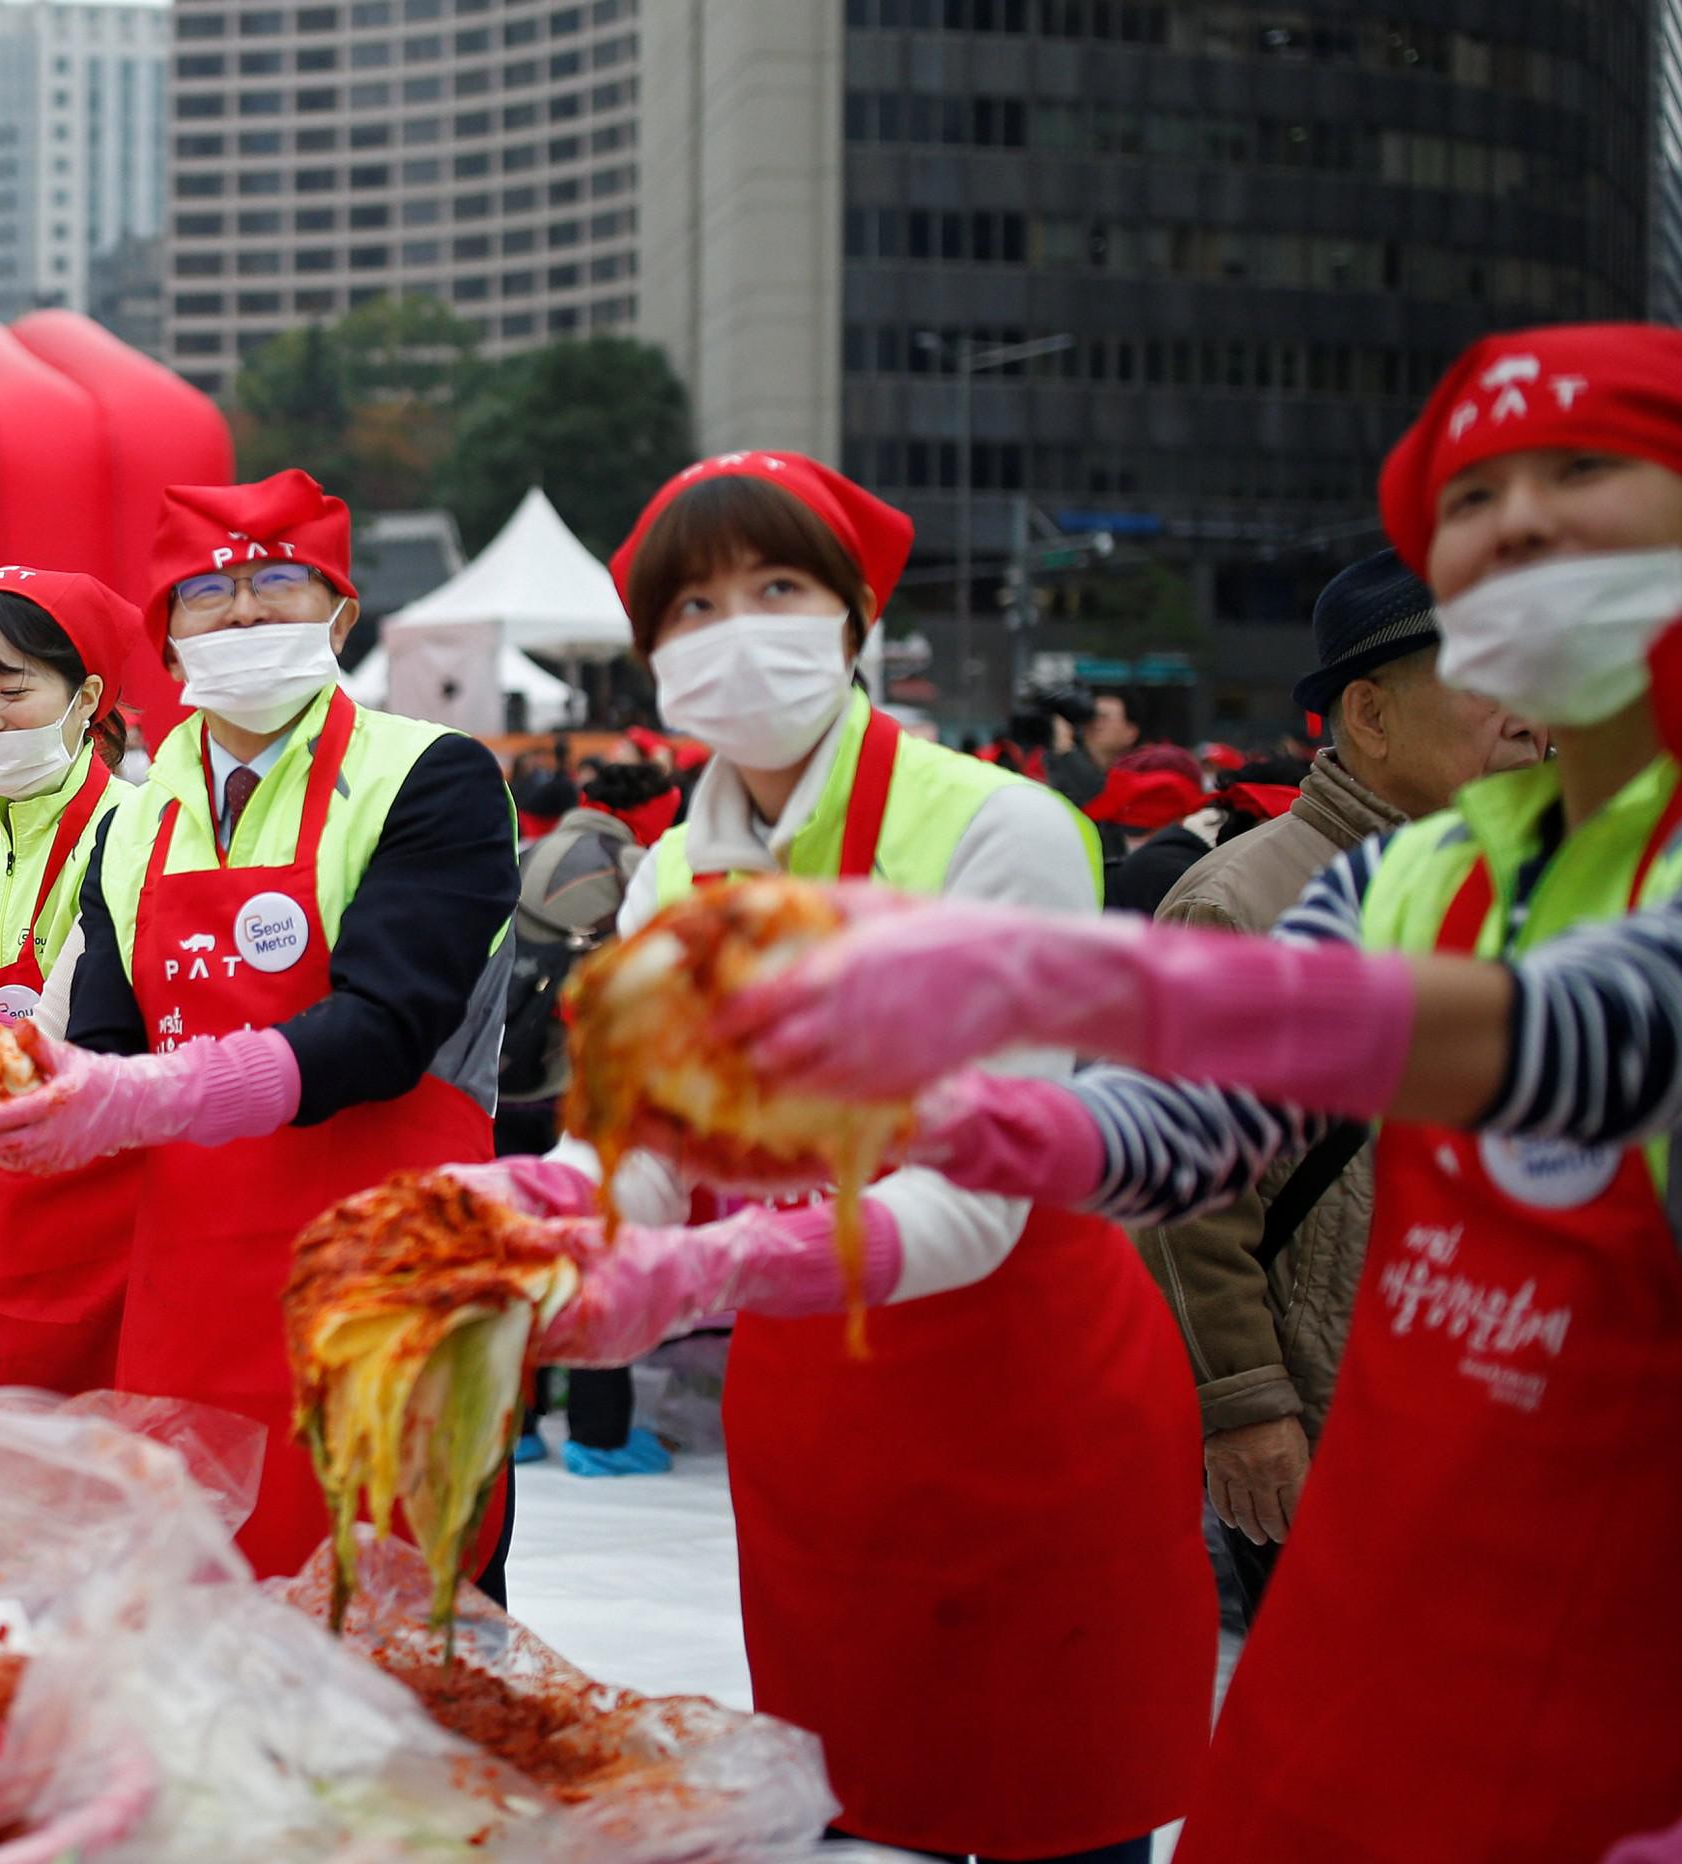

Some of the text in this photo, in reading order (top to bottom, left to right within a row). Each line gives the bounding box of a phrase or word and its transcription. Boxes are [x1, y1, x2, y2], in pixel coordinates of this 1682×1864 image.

[1447, 374, 1588, 441] PAT
[213, 542, 294, 569] PAT
[250, 916, 294, 940] Seoul
[256, 935, 297, 954] Metro
[164, 956, 242, 981] PAT
